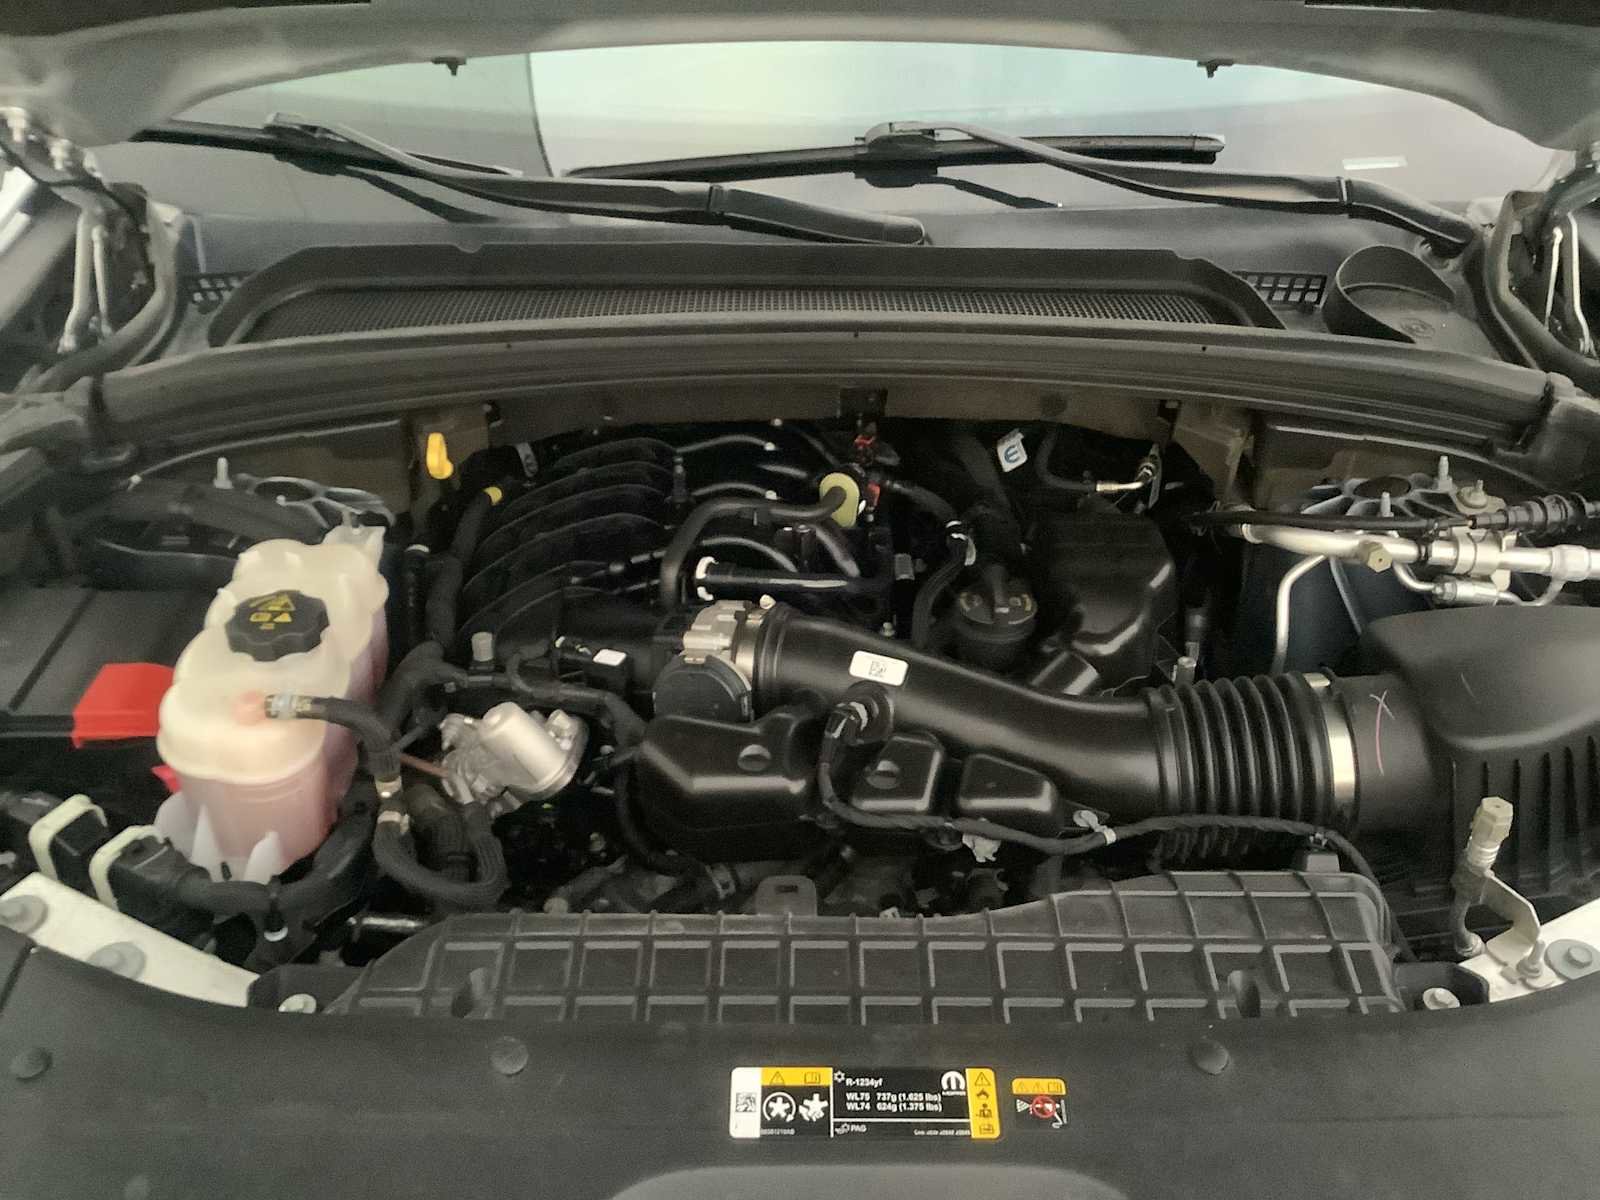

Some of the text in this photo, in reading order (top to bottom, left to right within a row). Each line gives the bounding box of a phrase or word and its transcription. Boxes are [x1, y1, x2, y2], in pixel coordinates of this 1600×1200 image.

[845, 1077, 883, 1089] R-1234yf
[845, 1092, 871, 1101] WL75
[876, 1092, 897, 1103] 737g
[845, 1102, 871, 1111] WL74
[899, 1102, 925, 1113] (1.375
